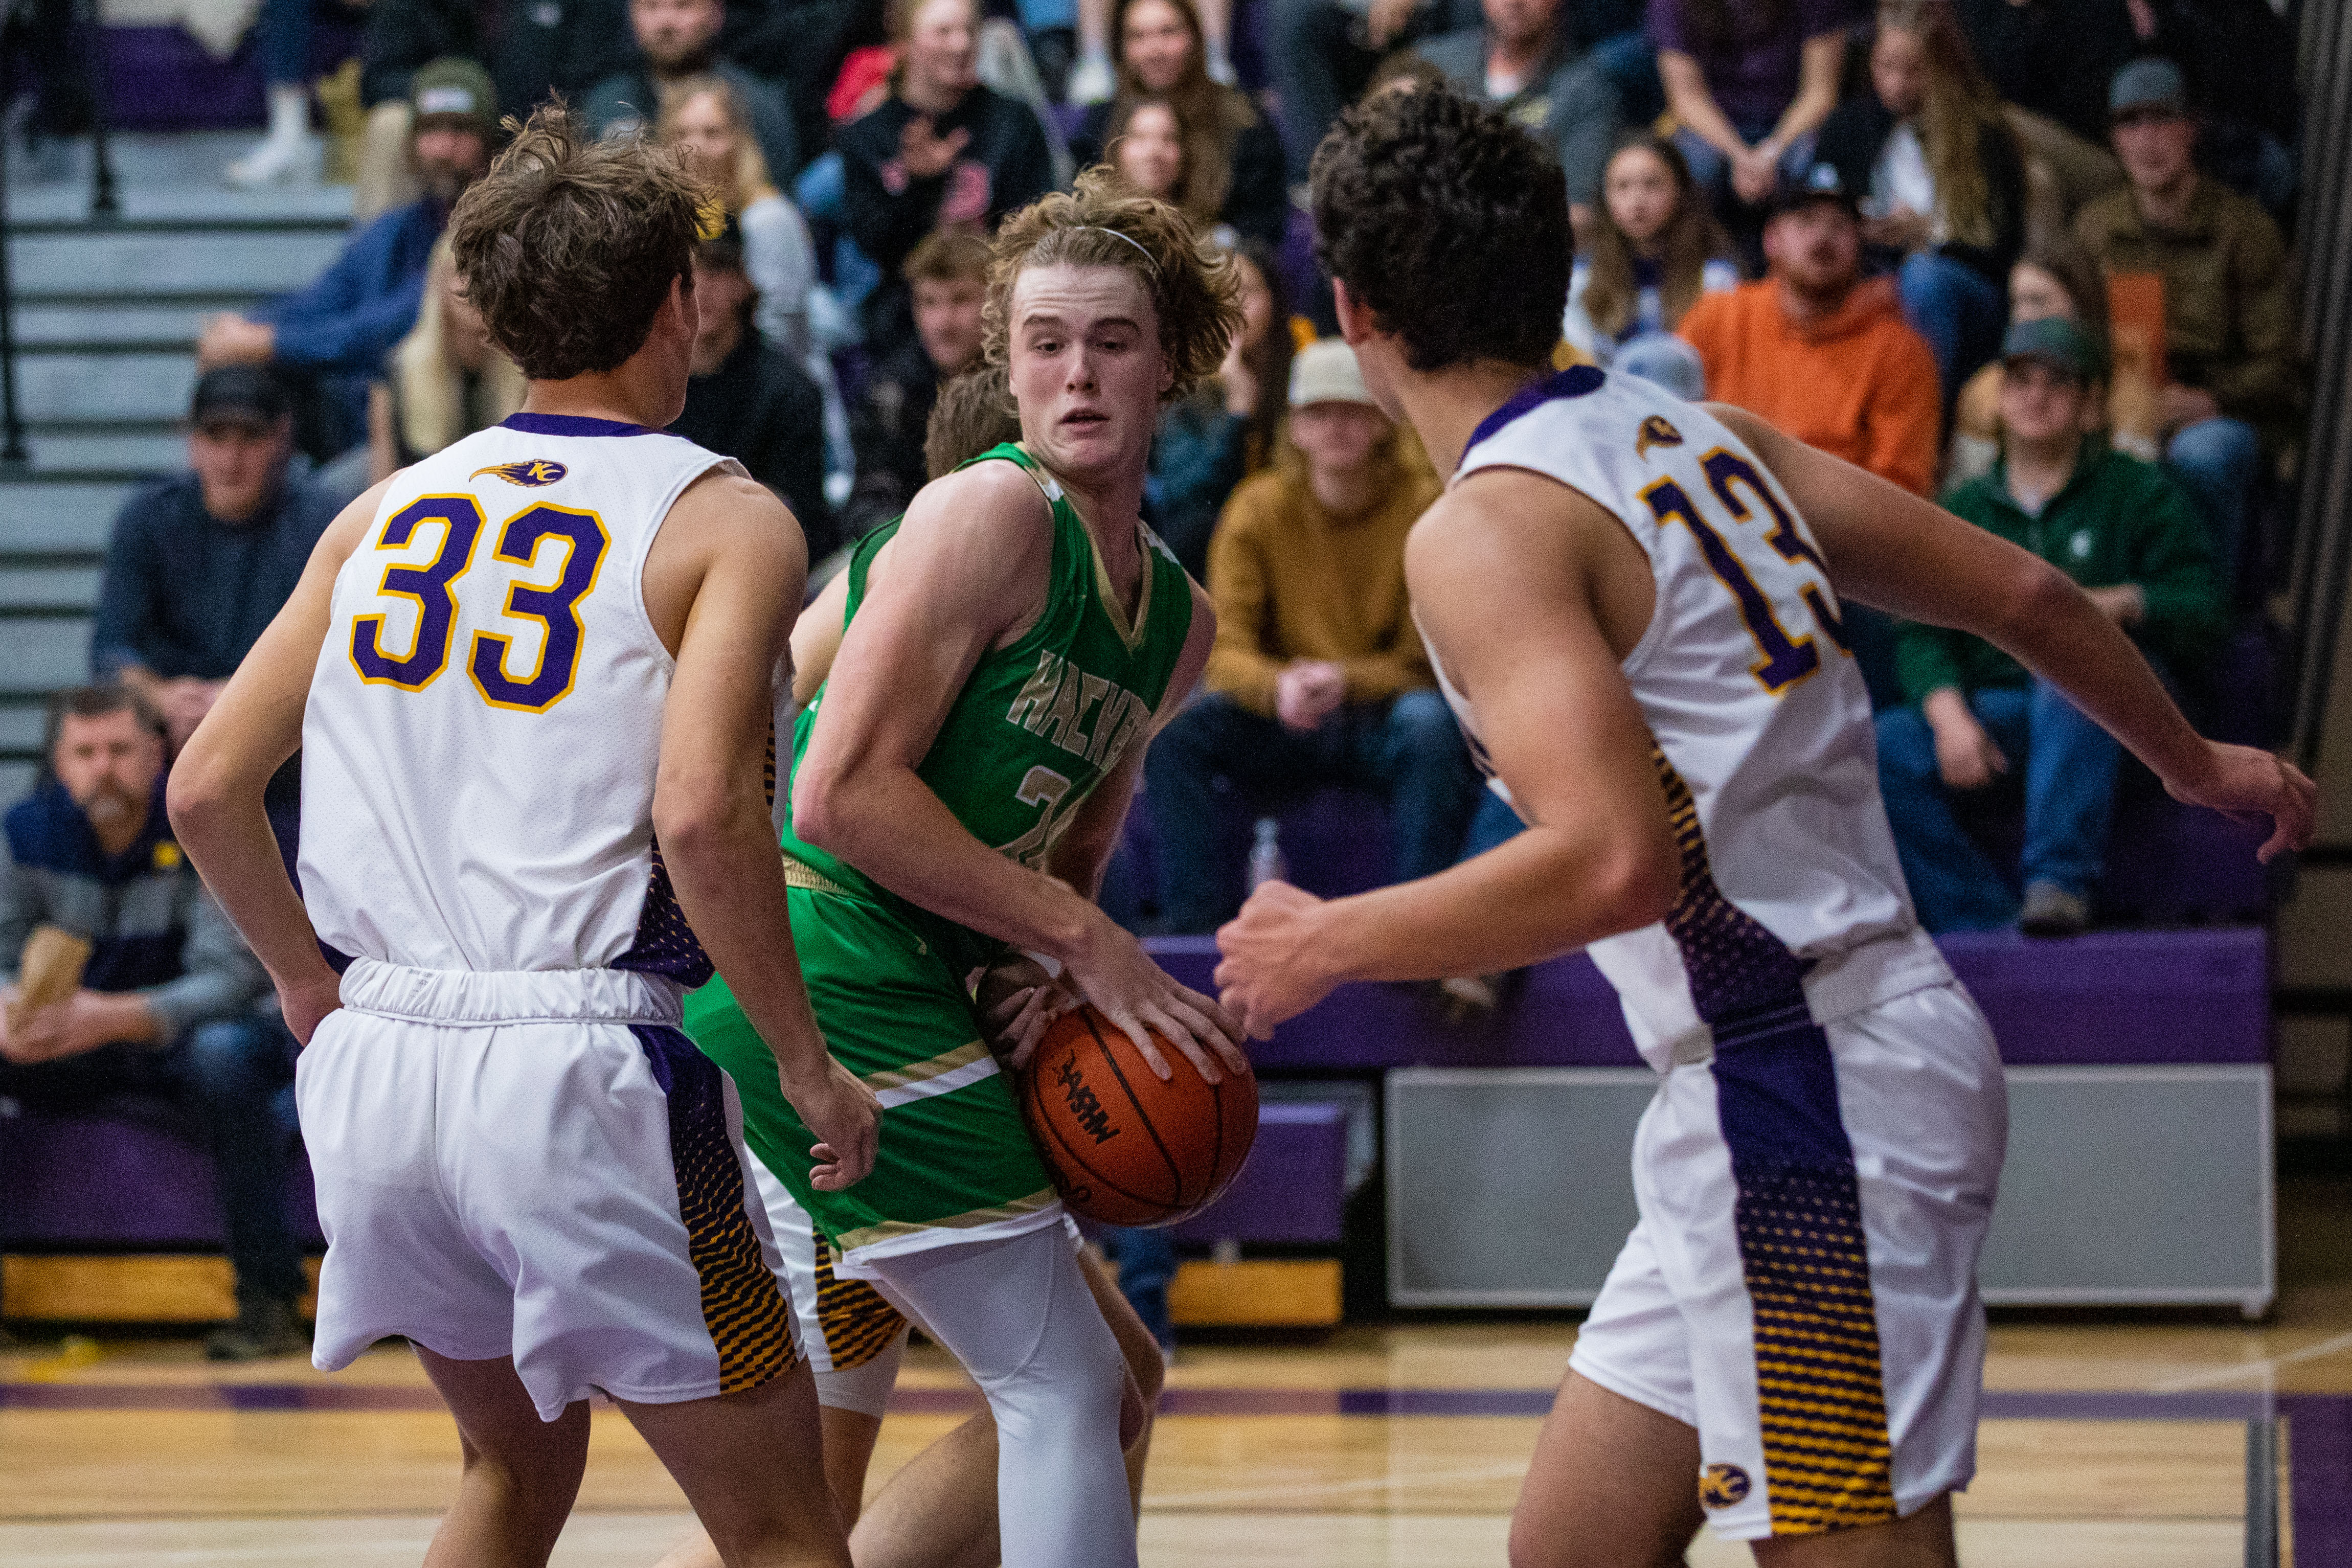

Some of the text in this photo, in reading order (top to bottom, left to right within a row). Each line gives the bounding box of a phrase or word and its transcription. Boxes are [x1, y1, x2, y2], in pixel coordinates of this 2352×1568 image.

[527, 462, 561, 482] KC
[1637, 446, 1853, 701] 13
[349, 493, 613, 715] 33
